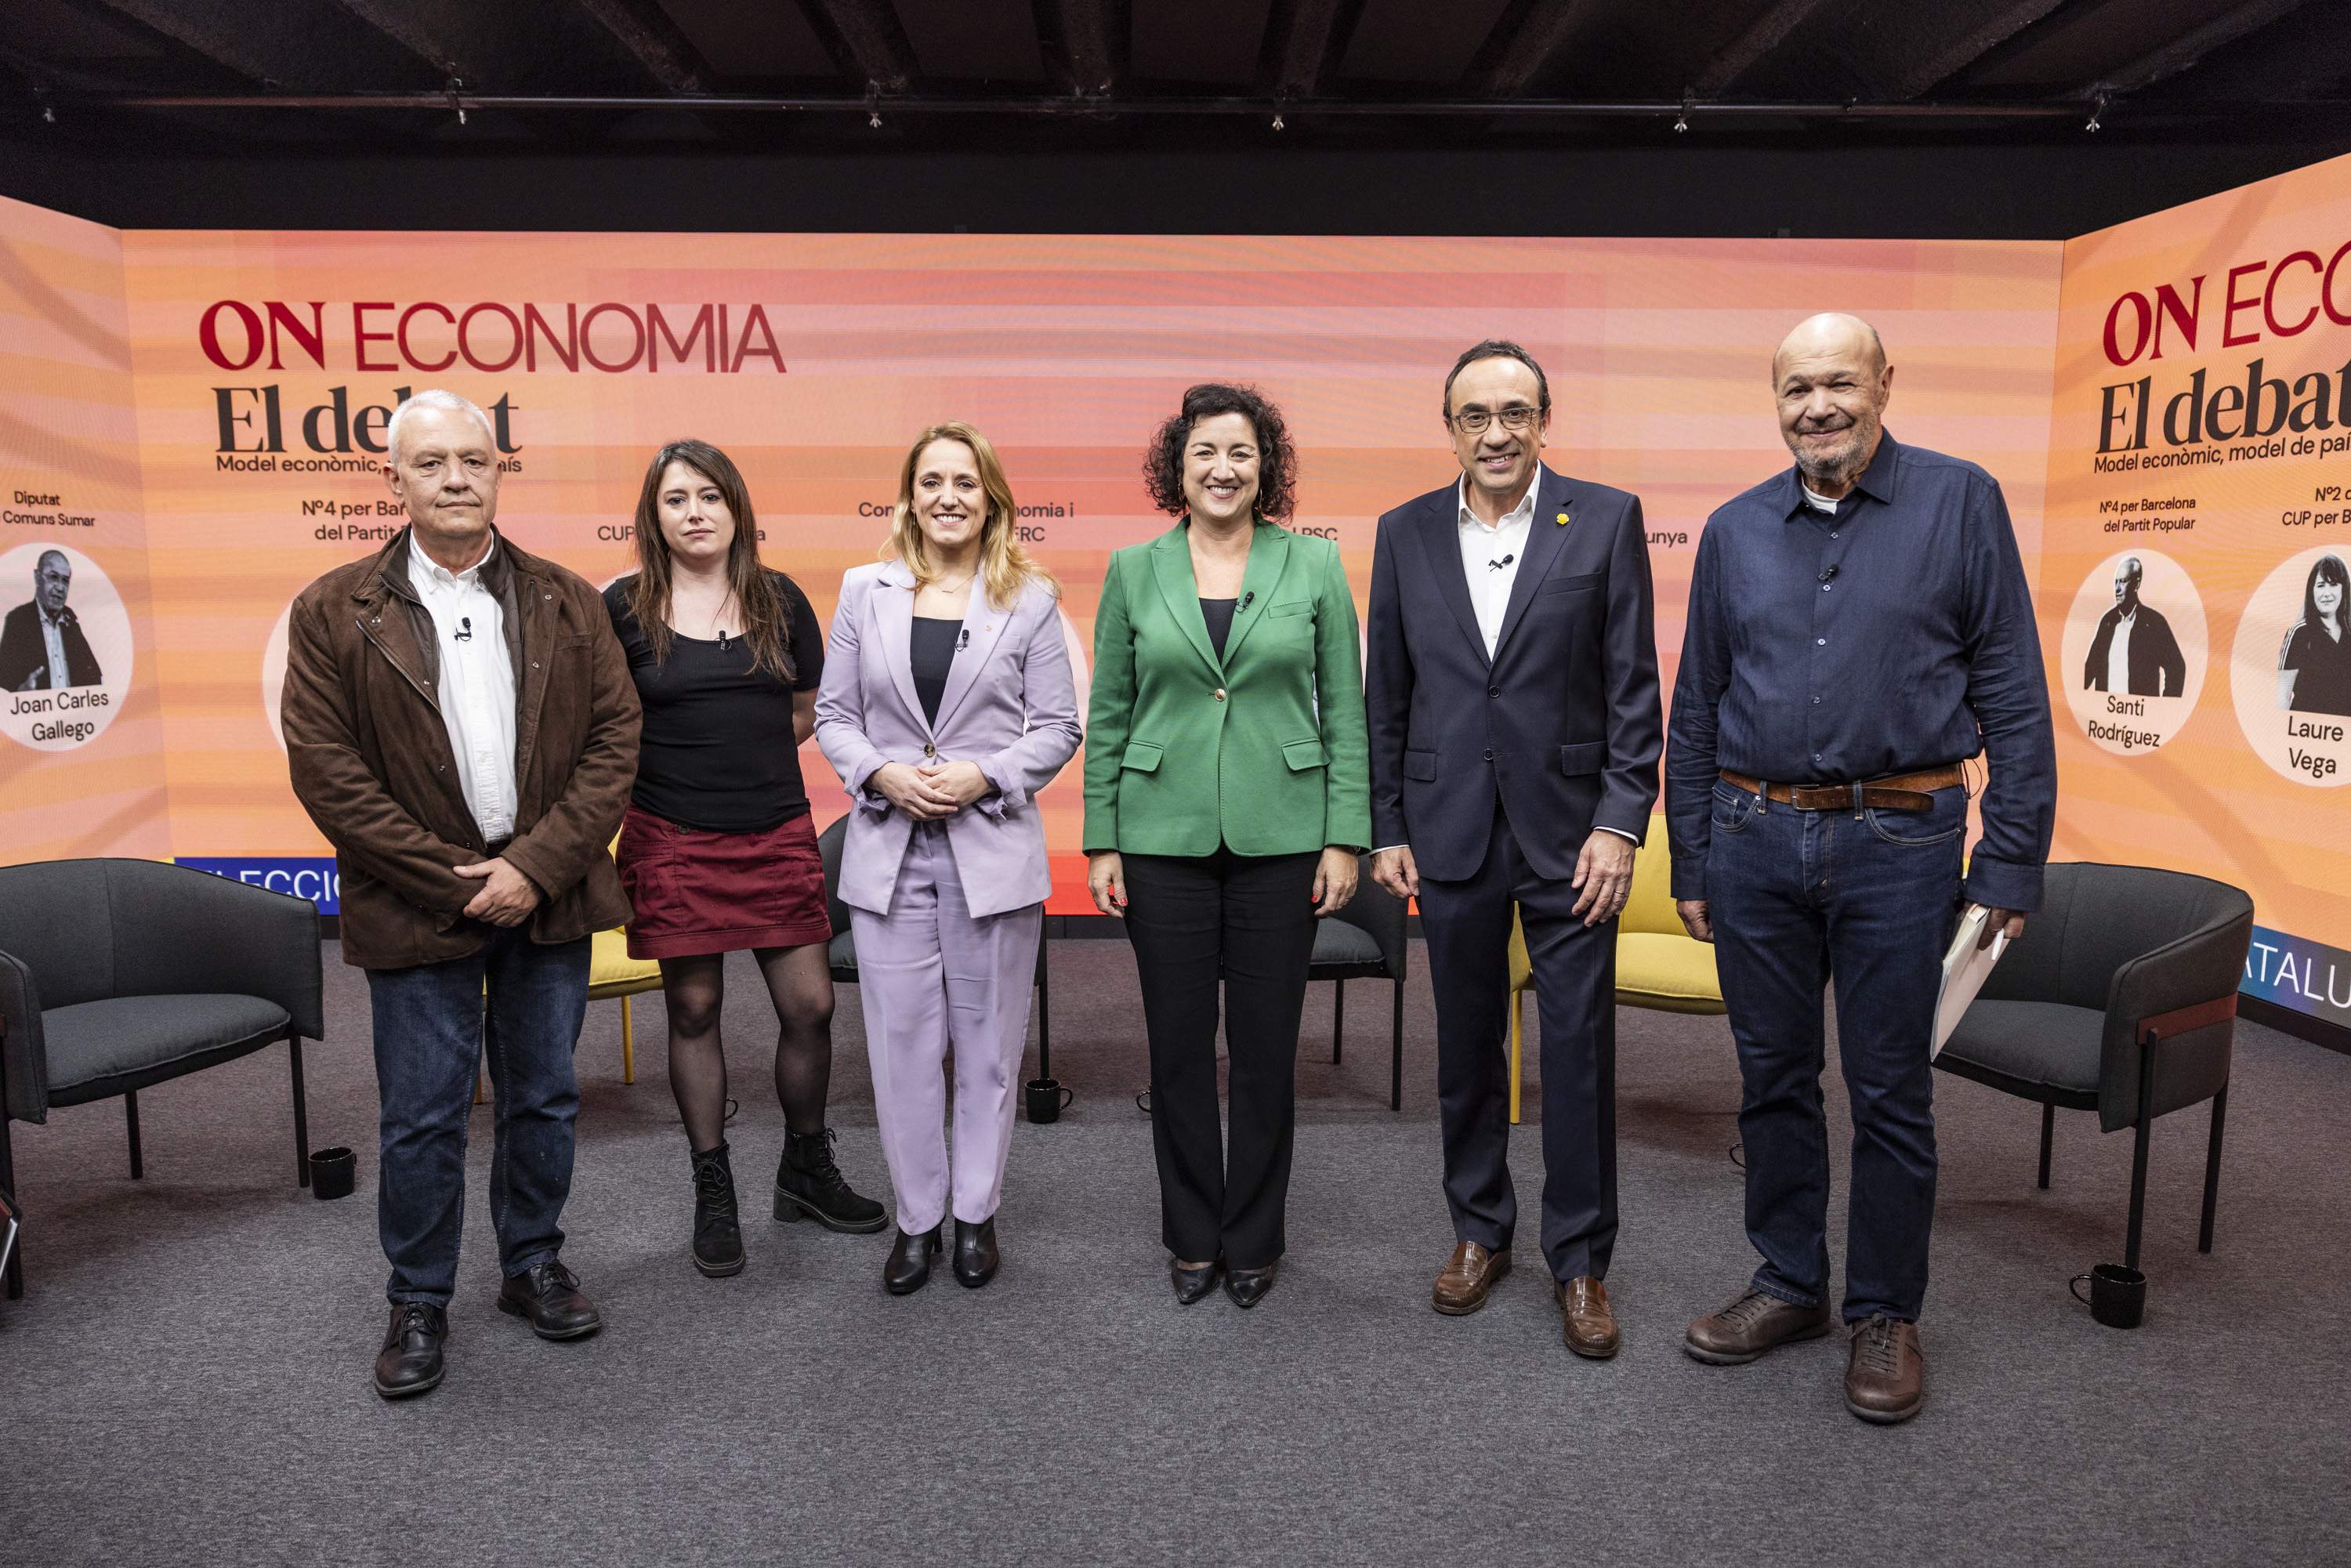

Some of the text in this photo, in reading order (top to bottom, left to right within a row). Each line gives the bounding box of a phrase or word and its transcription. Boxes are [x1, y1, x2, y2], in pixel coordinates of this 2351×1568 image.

[2103, 275, 2207, 366] ON
[199, 300, 787, 373] ON ECONOMIA
[211, 384, 523, 454] El det
[2096, 375, 2151, 454] El
[216, 454, 277, 472] Model
[281, 454, 382, 475] econòmic,
[2094, 453, 2138, 473] Model
[2142, 444, 2224, 469] econòmic,
[2229, 437, 2285, 461] model
[2290, 436, 2315, 455] de
[13, 491, 60, 508] Diputat
[2121, 502, 2139, 516] per
[2141, 496, 2197, 511] Barcelona
[3, 510, 96, 527] Comuns Sumar
[341, 504, 371, 520] per
[2282, 510, 2312, 526] CUP
[2314, 512, 2339, 529] per
[315, 524, 396, 540] del Partit
[598, 525, 635, 541] CUP
[2103, 516, 2196, 534] del Partit Popular
[10, 690, 109, 715] Joan Carles
[2106, 695, 2145, 716] Santi
[32, 720, 95, 741] Gallego
[2088, 720, 2161, 748] Rodríguez
[2288, 715, 2344, 742] Laure
[2288, 747, 2337, 779] Vega
